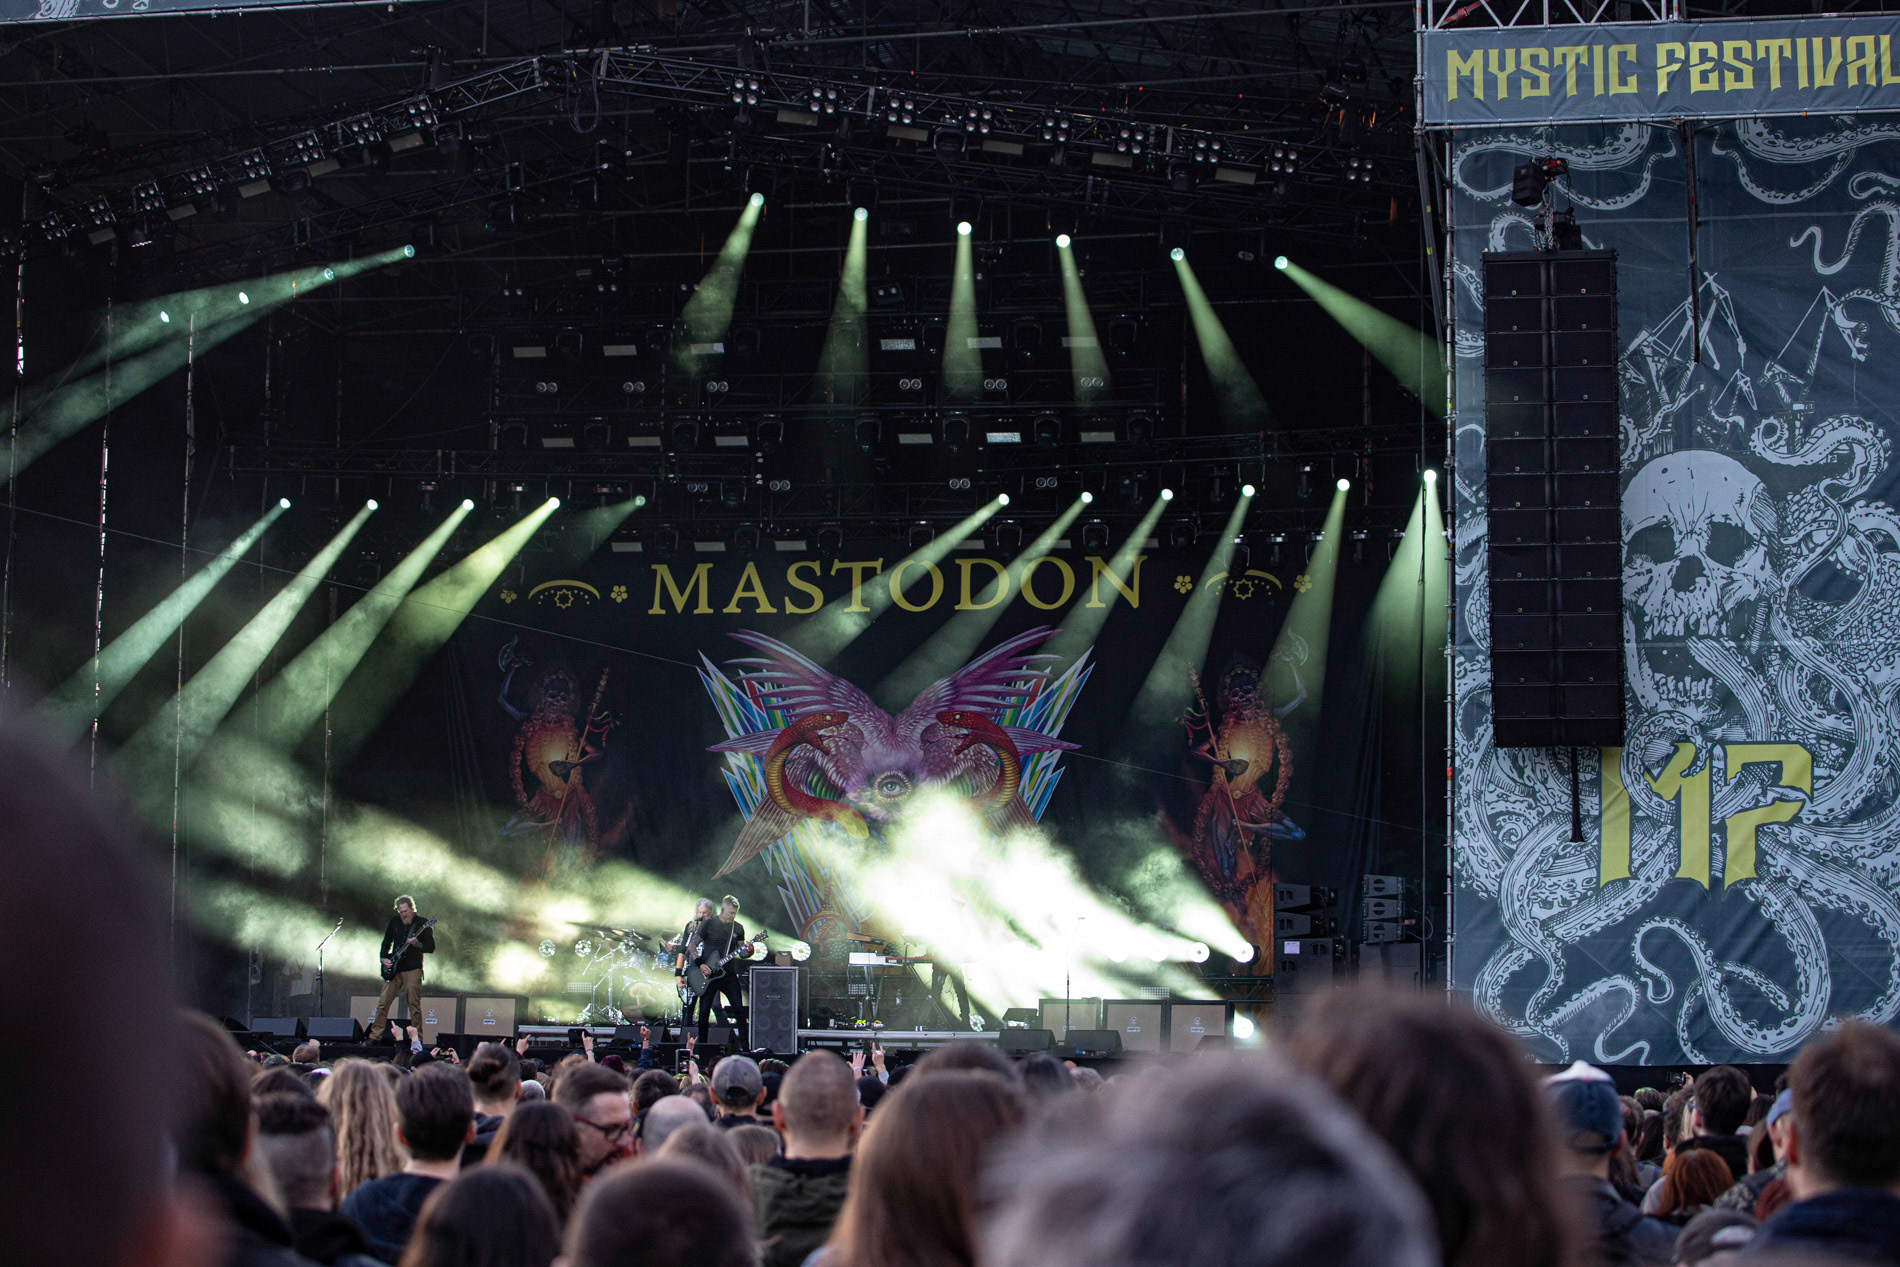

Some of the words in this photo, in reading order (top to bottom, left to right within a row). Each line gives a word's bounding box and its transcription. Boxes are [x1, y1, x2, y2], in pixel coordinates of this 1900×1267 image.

[1446, 44, 1638, 102] MYSTIC
[1656, 34, 1900, 96] FESTIVAL
[647, 555, 1147, 616] MASTODON
